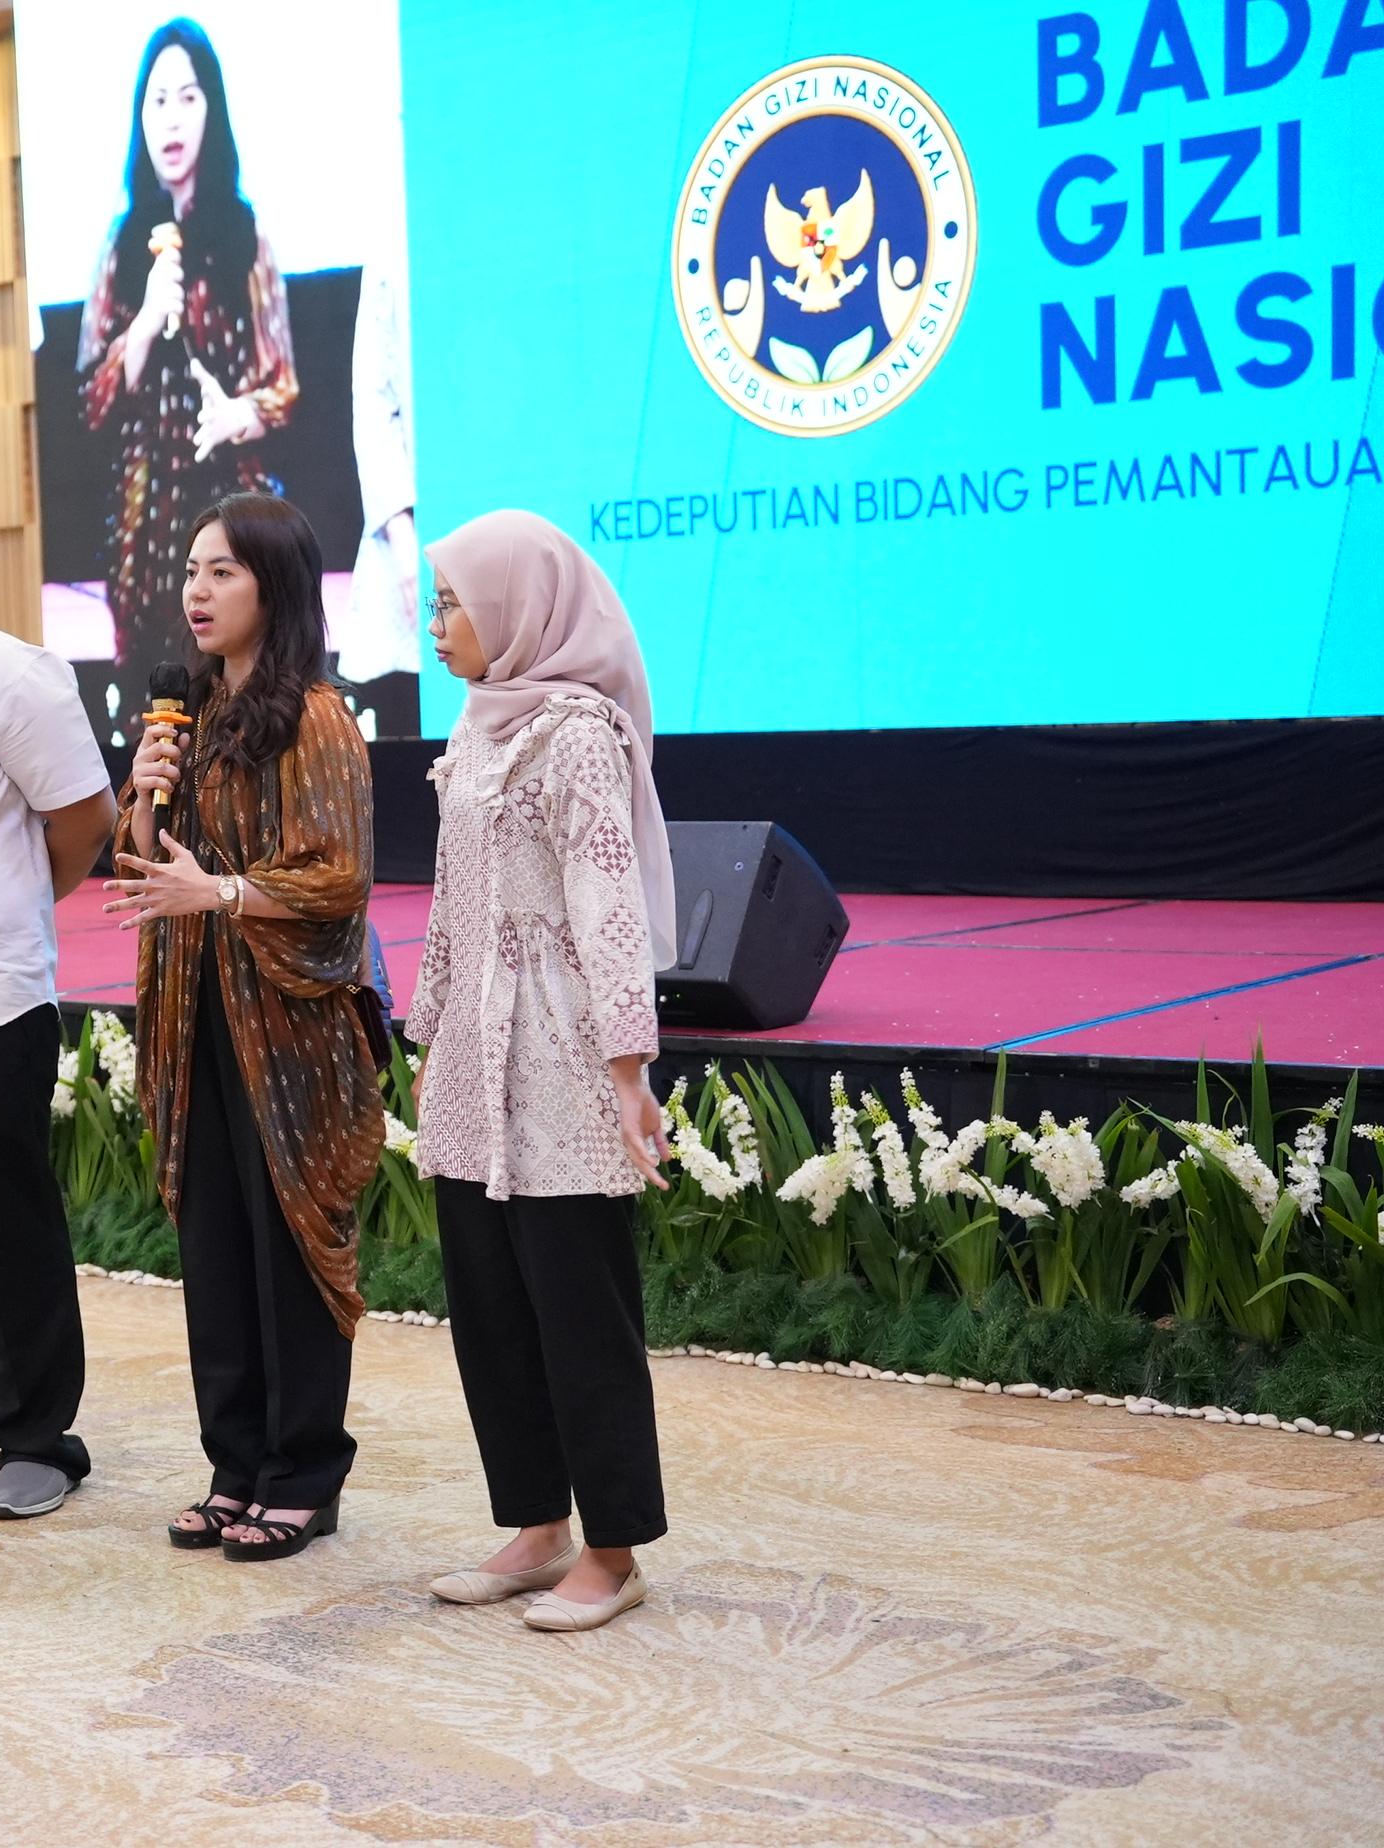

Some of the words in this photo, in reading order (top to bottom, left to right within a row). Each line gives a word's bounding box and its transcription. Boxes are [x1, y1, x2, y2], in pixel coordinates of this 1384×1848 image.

[691, 116, 754, 226] BADAN
[764, 77, 818, 116] GIZI
[833, 75, 950, 191] NASIONAL
[1036, 119, 1301, 268] GIZI
[696, 305, 805, 418] REPUBLIK
[822, 279, 952, 417] INDONESIA
[1040, 262, 1384, 410] NASI
[590, 482, 840, 542] KEDEPUTIAN
[855, 468, 1029, 523] BIDANG
